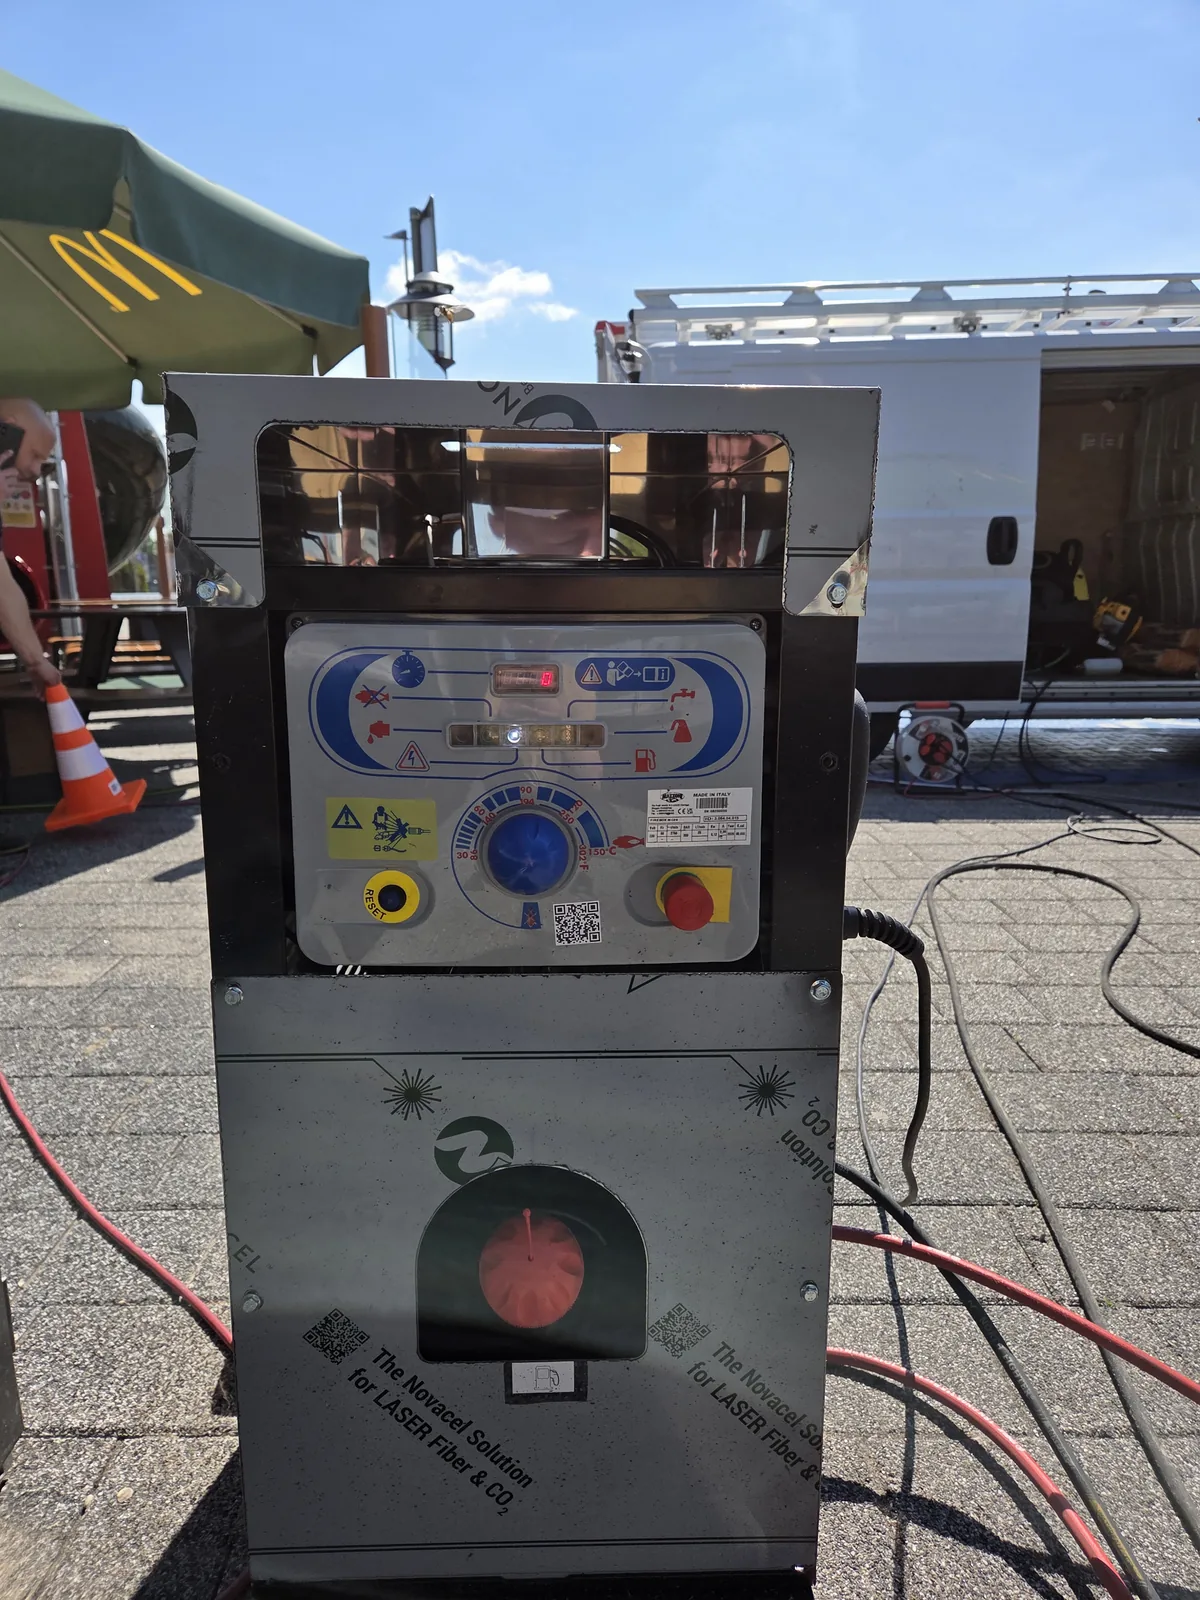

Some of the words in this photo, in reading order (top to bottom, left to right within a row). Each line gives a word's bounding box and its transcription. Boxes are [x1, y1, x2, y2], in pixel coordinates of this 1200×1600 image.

[519, 786, 533, 794] 90
[473, 805, 486, 816] 60
[569, 799, 583, 814] 120
[482, 812, 497, 826] 140
[559, 809, 575, 824] 250
[456, 851, 468, 859] 30
[365, 888, 387, 920] RESET
[712, 1340, 743, 1375] The
[739, 1368, 807, 1428] Novacel
[372, 1347, 405, 1381] The
[401, 1374, 473, 1435] Novacel
[466, 1429, 533, 1489] Solution
[686, 1361, 716, 1388] for
[710, 1382, 767, 1434] LASER
[760, 1428, 805, 1468] Fiber
[800, 1464, 820, 1482] &
[347, 1367, 378, 1395] for
[373, 1389, 433, 1441] LASER
[427, 1434, 473, 1475] Fiber
[469, 1469, 488, 1488] &
